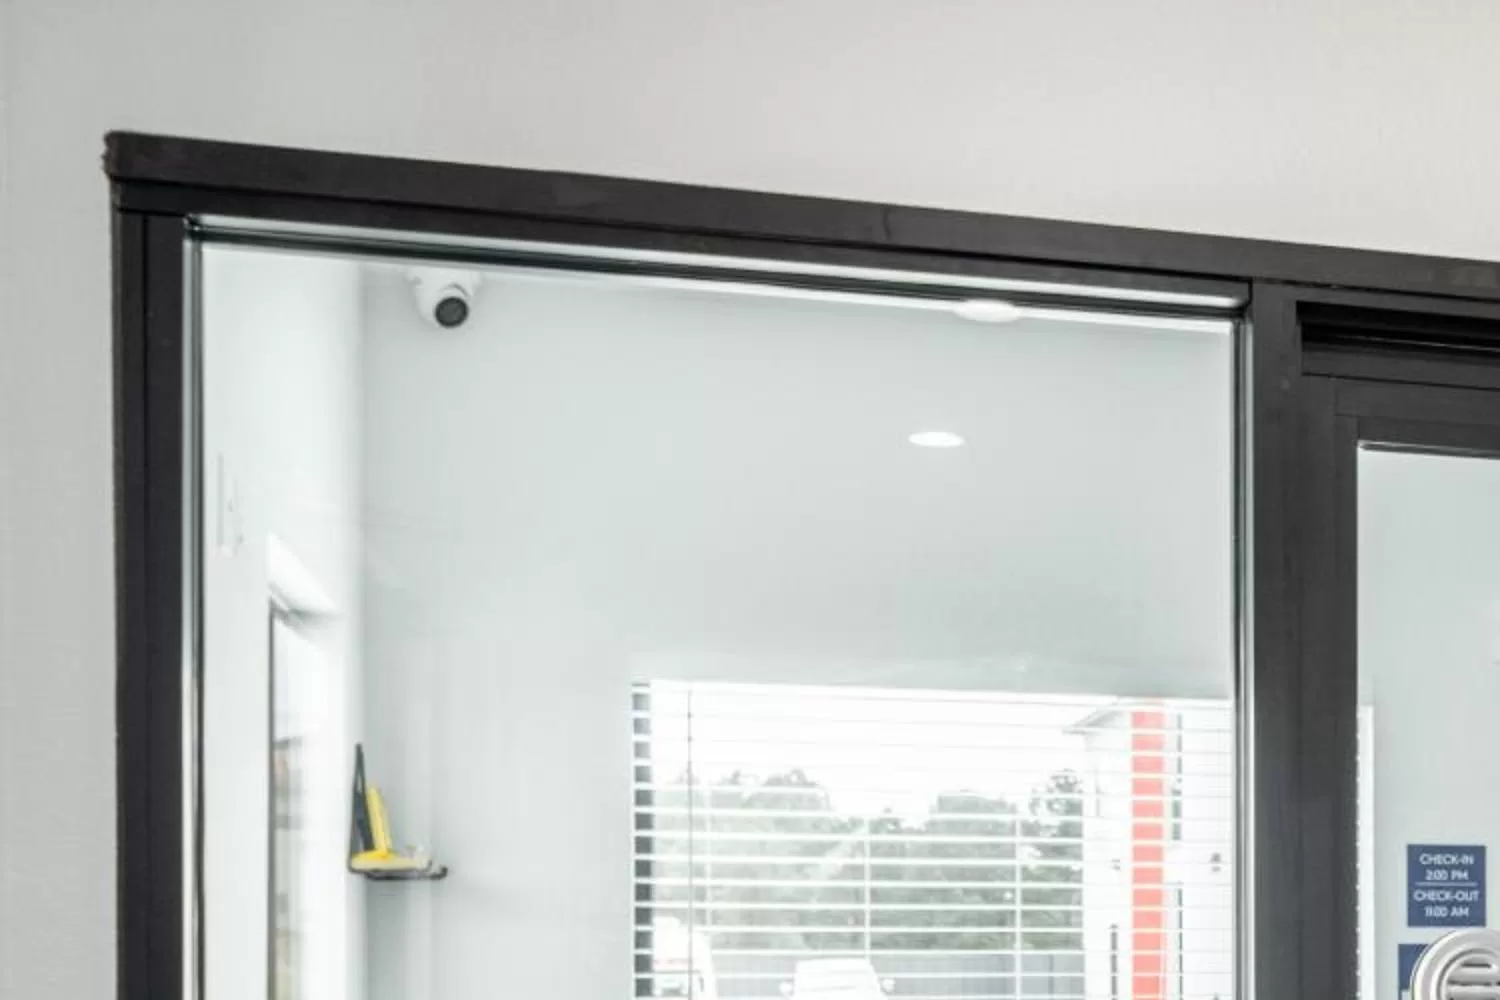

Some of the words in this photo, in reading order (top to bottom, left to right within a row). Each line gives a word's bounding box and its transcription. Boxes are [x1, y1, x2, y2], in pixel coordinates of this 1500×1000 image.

[1419, 853, 1475, 865] CHECK-IN
[1451, 870, 1469, 881] PM
[1413, 889, 1480, 901] CHECK-OUT
[1450, 906, 1470, 917] AM
